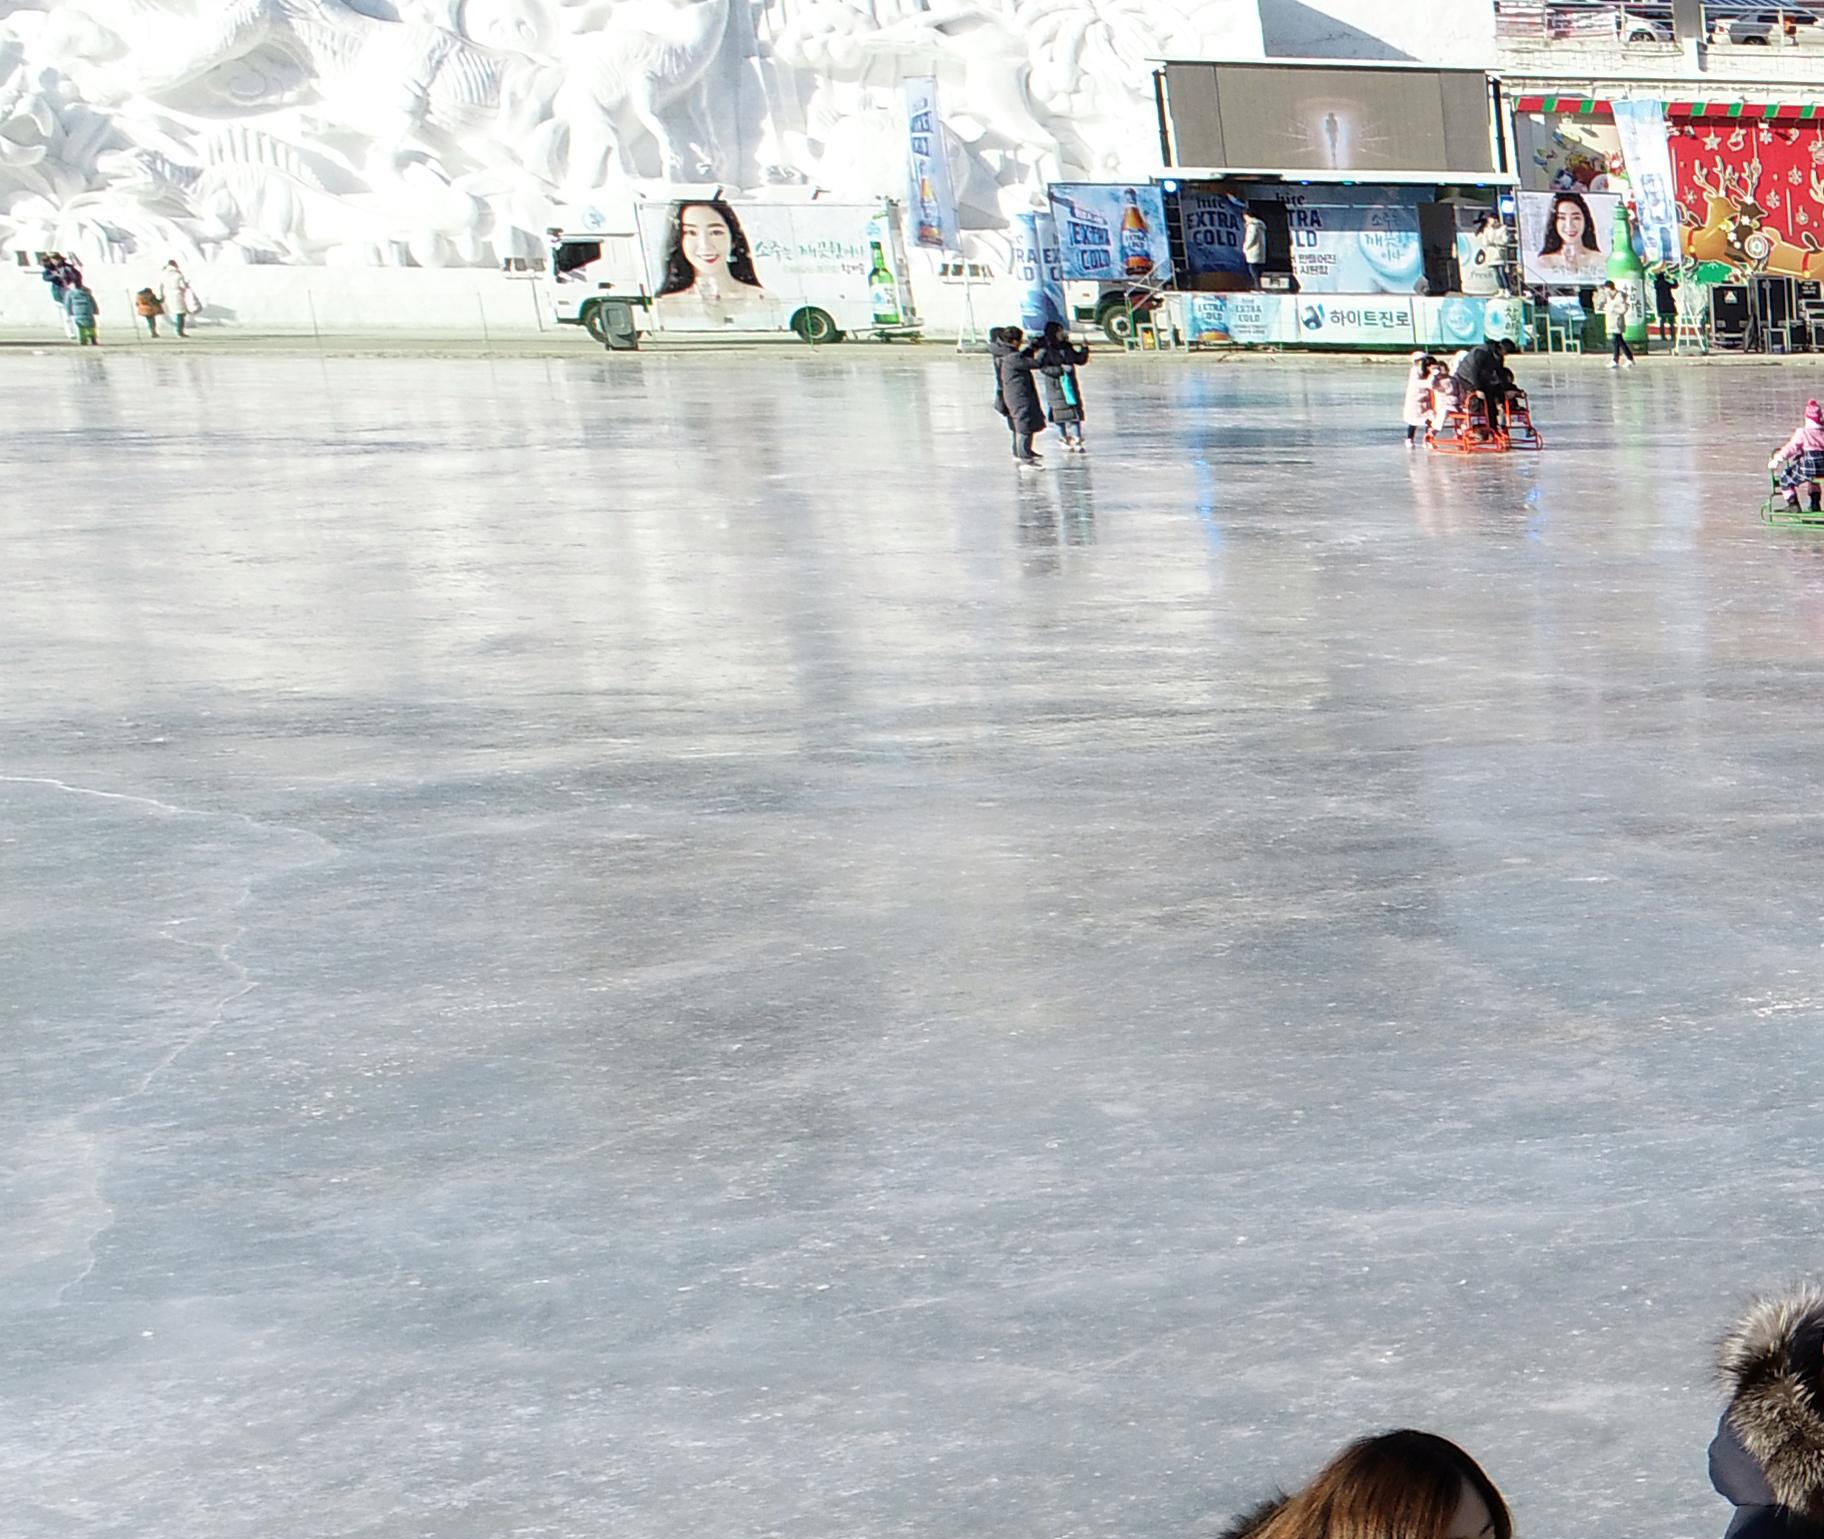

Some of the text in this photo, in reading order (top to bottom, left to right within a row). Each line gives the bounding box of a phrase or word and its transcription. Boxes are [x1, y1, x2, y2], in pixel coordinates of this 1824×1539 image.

[1187, 211, 1240, 231] EXTRA
[1288, 210, 1322, 227] TRA
[1193, 229, 1237, 248] COLD
[1296, 231, 1318, 248] LD
[1330, 310, 1411, 328] 하이트진로
